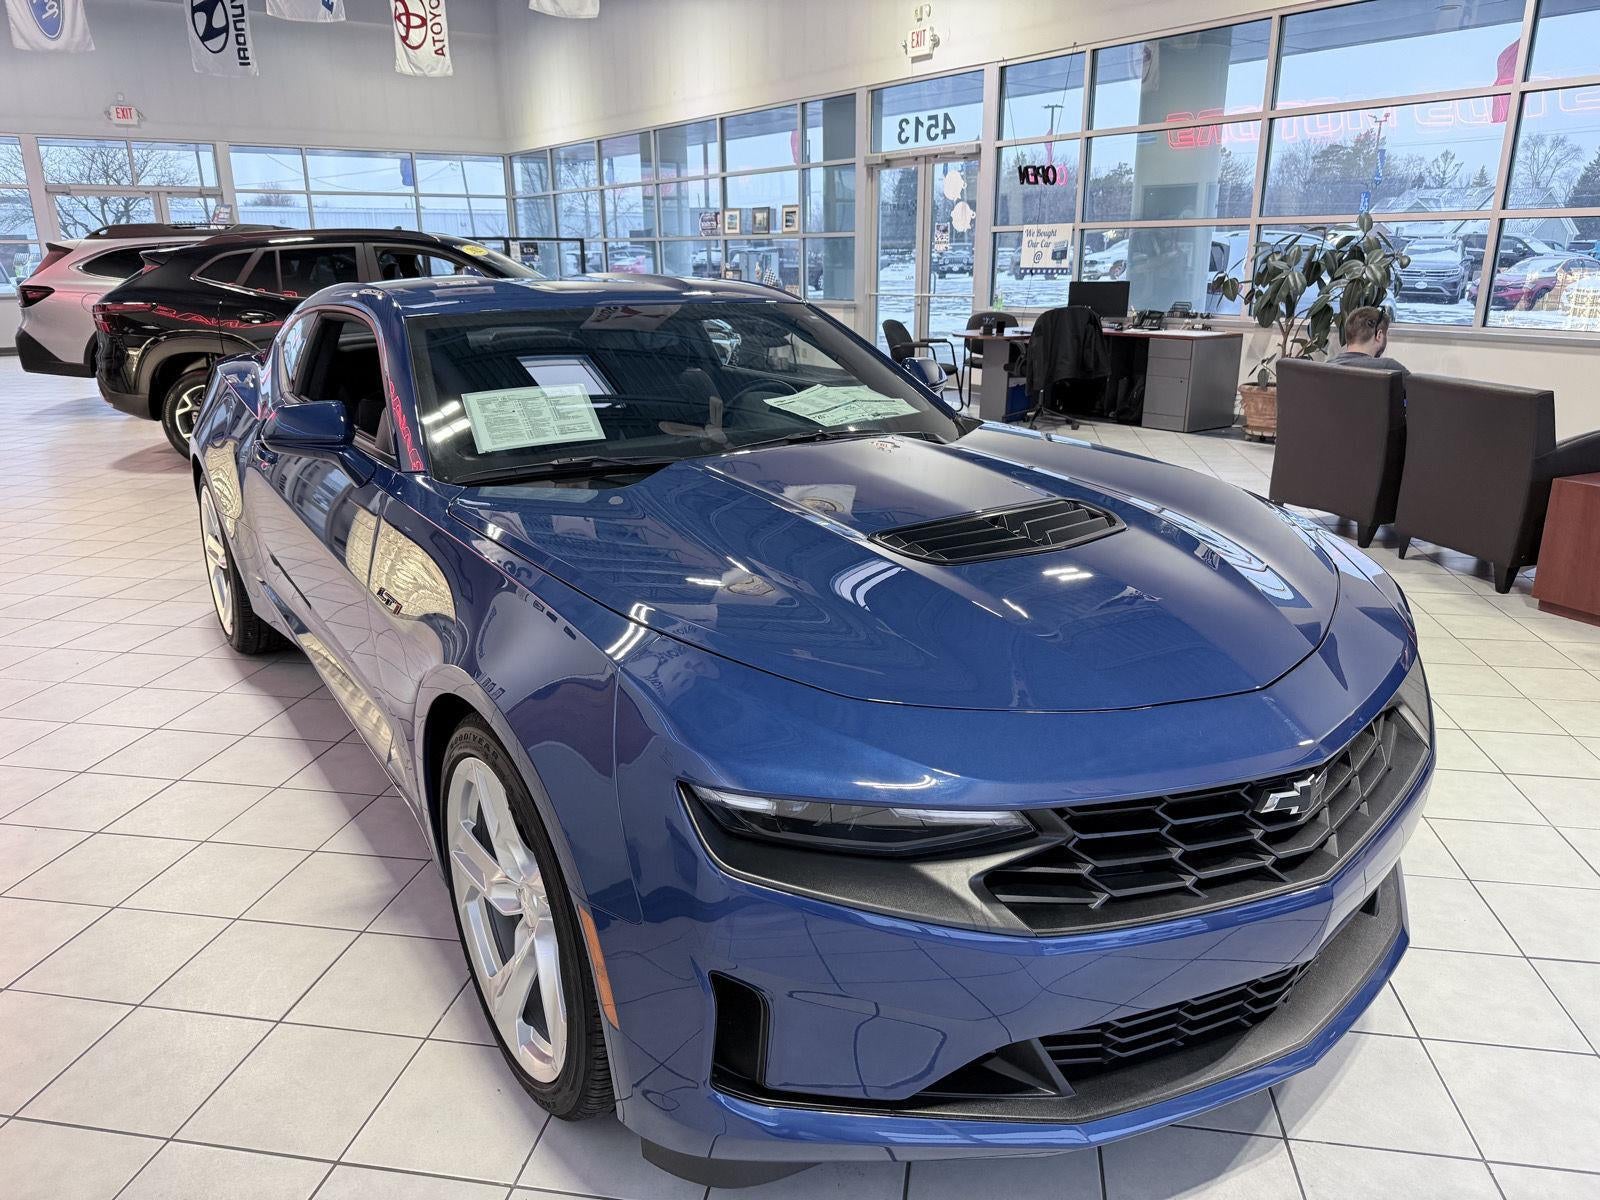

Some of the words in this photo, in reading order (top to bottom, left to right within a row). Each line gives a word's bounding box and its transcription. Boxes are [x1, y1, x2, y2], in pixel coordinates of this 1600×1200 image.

[911, 28, 926, 48] EXIT
[115, 107, 132, 120] EXIT
[1025, 229, 1035, 238] We
[1036, 228, 1057, 240] Bought
[1027, 239, 1039, 249] Our
[1040, 239, 1052, 248] Car
